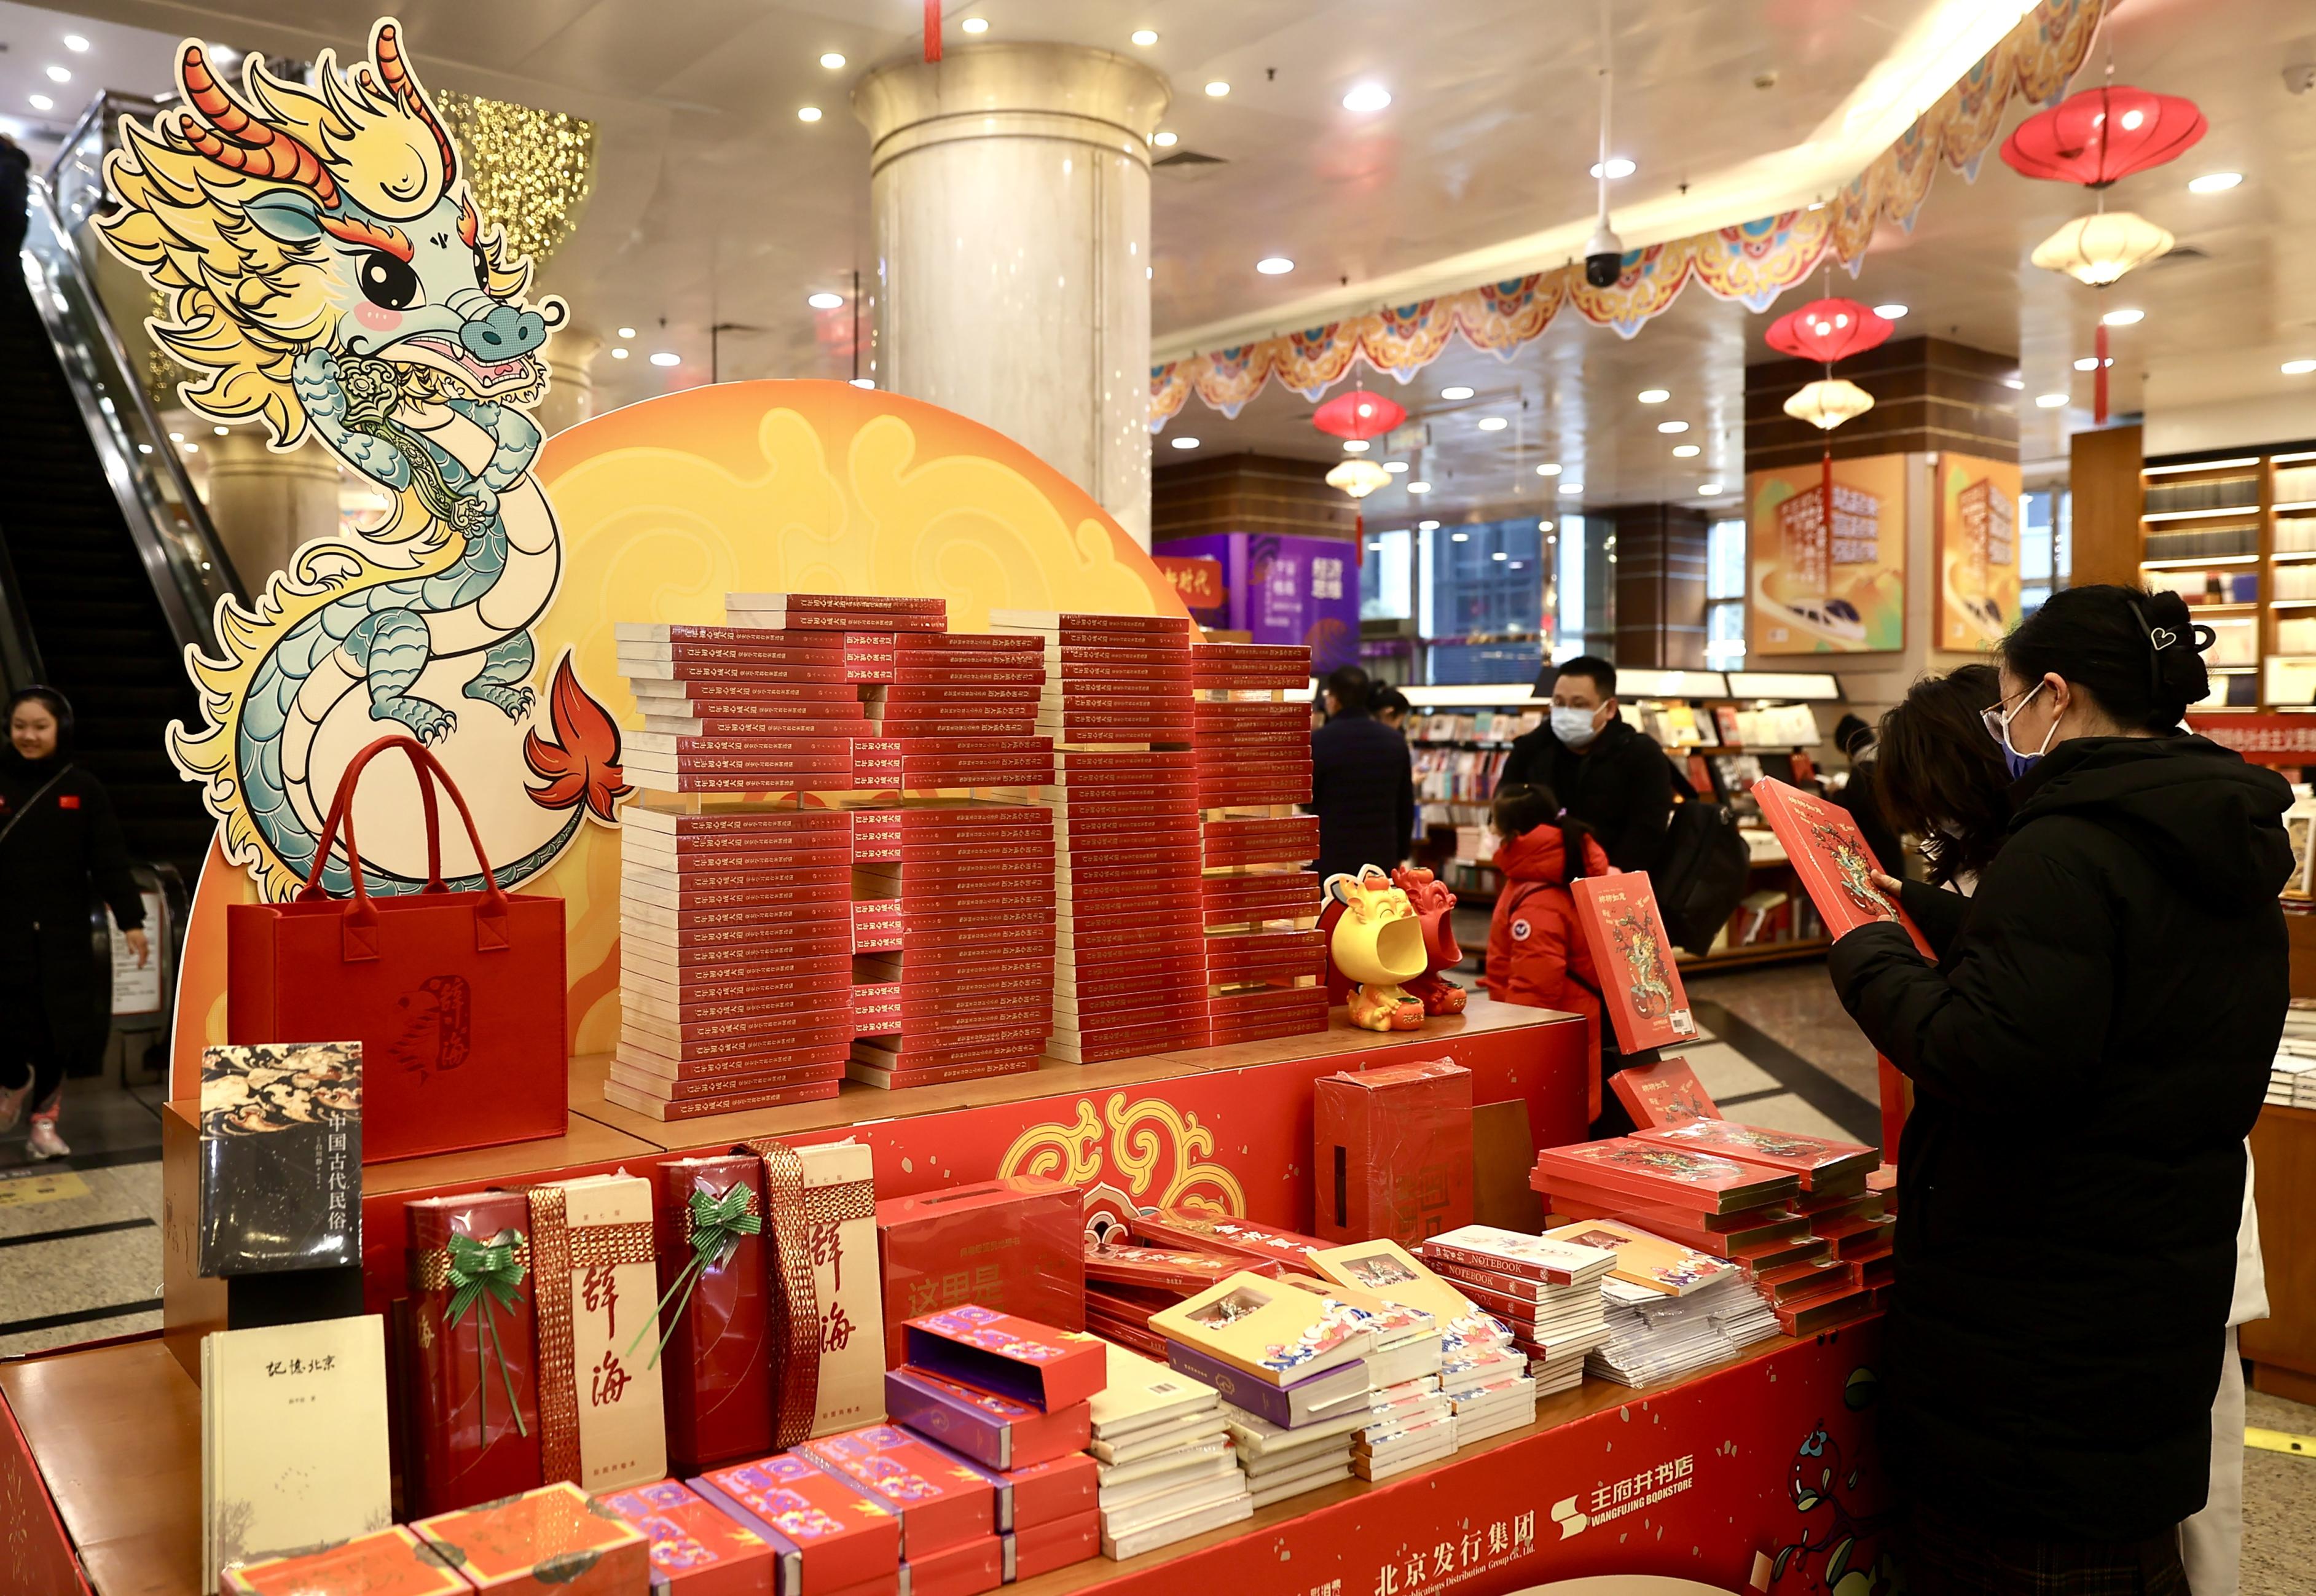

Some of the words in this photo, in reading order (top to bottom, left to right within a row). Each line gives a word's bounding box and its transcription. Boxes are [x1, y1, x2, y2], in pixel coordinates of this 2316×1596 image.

[847, 635, 892, 645] 百年初心成大道
[847, 652, 892, 662] 百年初心成大道
[847, 670, 892, 679] 百年初心成大道
[855, 741, 901, 750] 百年初心成大道
[855, 758, 901, 767] 百年初心成大道
[854, 776, 900, 786] 百年初心成大道
[855, 815, 901, 824] 百年初心成大道
[855, 831, 901, 842] 百年初心成大道
[855, 848, 901, 859] 百年初心成大道
[854, 904, 901, 913] 百年初心成大道
[855, 920, 902, 930] 百年初心成大道
[857, 936, 902, 950] 百年初心成大道
[854, 985, 901, 998] 百年初心成大道
[854, 1002, 901, 1015] 百年初心成大道
[854, 1019, 901, 1033] 百年初心成大道
[328, 1113, 347, 1230] 中国古代民俗
[1472, 1254, 1522, 1273] NOTEBOOK
[1449, 1265, 1494, 1286] NOTEBOOK
[908, 1263, 1003, 1320] 这里是
[1591, 1454, 1694, 1512] 王府井书店
[1591, 1497, 1645, 1527] WANGFUJING
[1646, 1477, 1693, 1505] BOOKSTORE
[1374, 1509, 1535, 1596] 北京发行集团
[1403, 1582, 1445, 1596] blications
[1446, 1563, 1486, 1587] Distribution
[1488, 1555, 1509, 1571] Group
